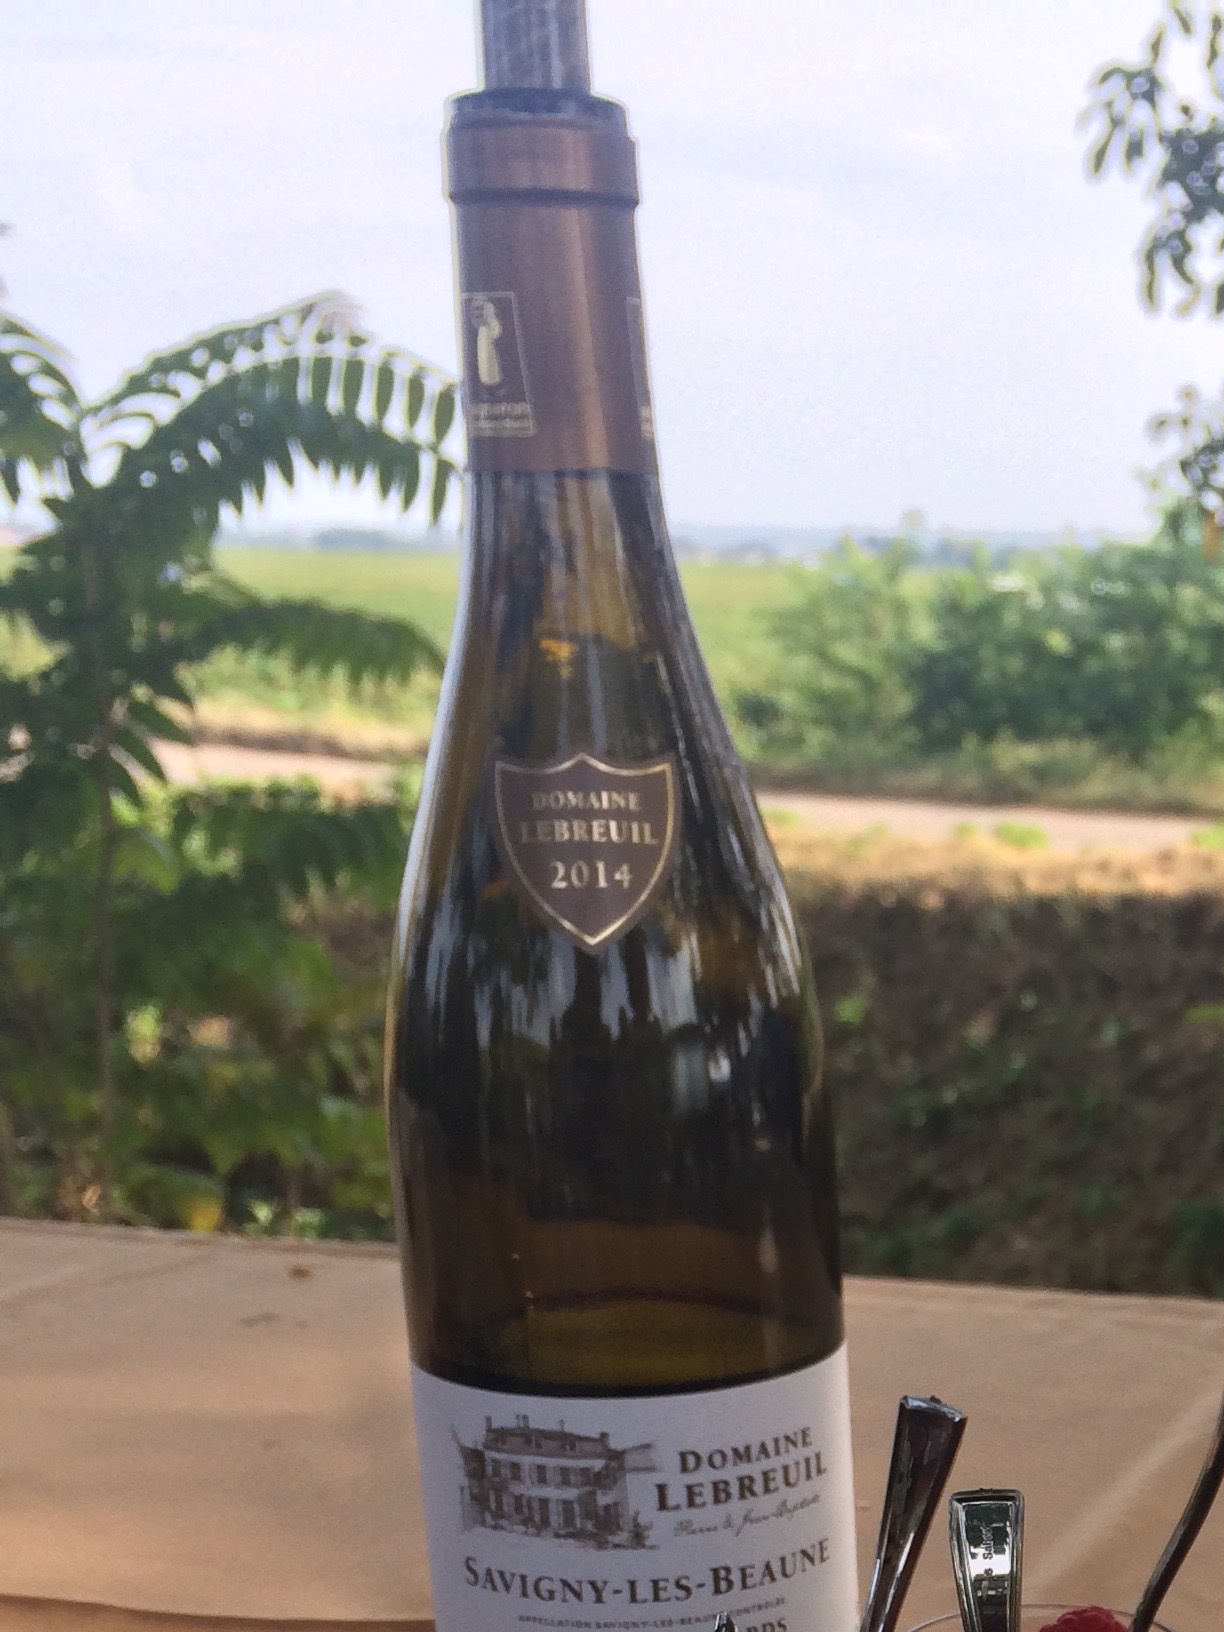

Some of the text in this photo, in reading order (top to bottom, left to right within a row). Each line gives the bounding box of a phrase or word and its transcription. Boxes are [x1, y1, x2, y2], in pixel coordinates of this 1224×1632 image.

[531, 790, 642, 812] DOMAINE
[518, 819, 660, 845] LEBREUIL
[550, 860, 633, 889] 2014
[678, 1426, 814, 1475] DOMAINE
[653, 1451, 829, 1513] LEBREUIL
[464, 1536, 831, 1604] SAVIGNY-LES-BEAUNE
